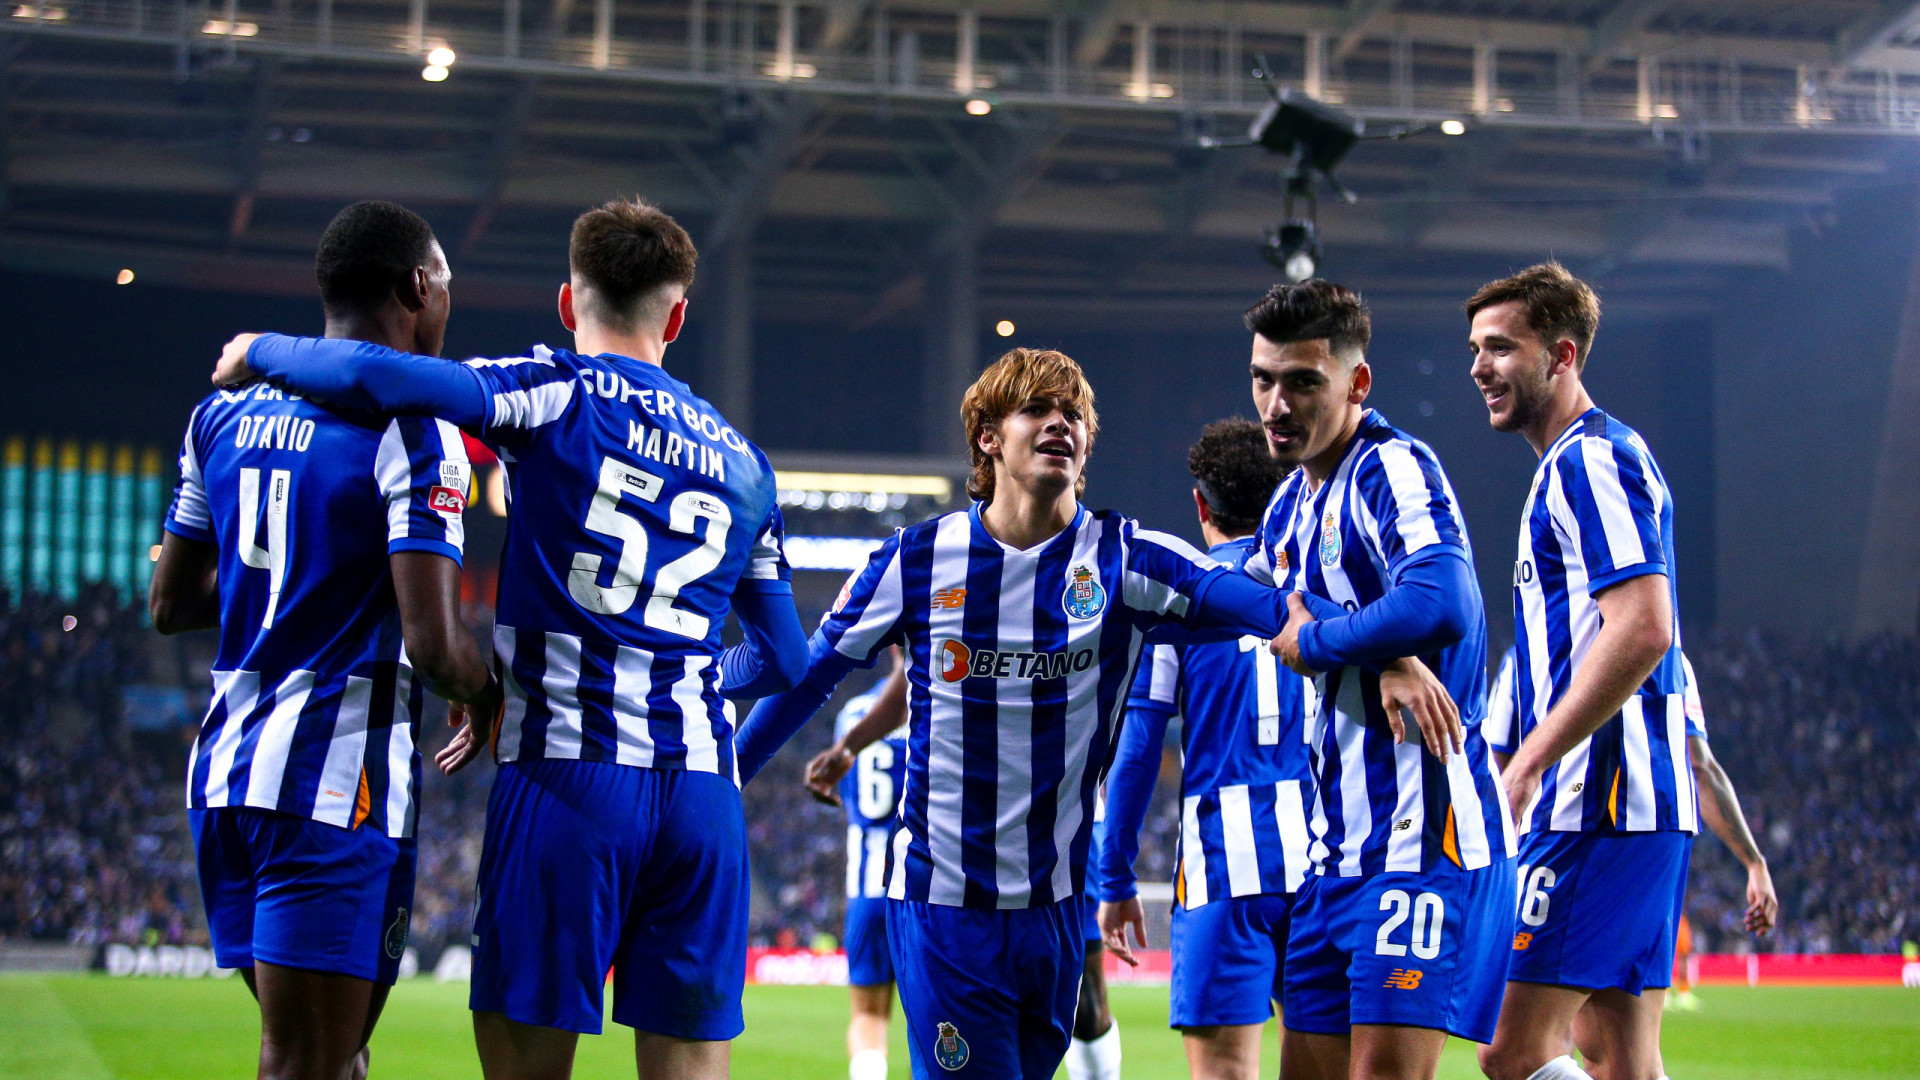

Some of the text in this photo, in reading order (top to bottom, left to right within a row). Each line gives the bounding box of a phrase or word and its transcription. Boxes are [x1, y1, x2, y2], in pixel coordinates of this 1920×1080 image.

[579, 368, 678, 420] SUPER
[235, 415, 316, 452] OTAVIO
[627, 419, 725, 483] MARTIM
[442, 464, 460, 476] LIGA
[239, 467, 291, 629] 4
[567, 456, 732, 641] 52
[971, 648, 1094, 680] BETANO
[858, 741, 894, 819] 6
[1375, 889, 1444, 960] 20
